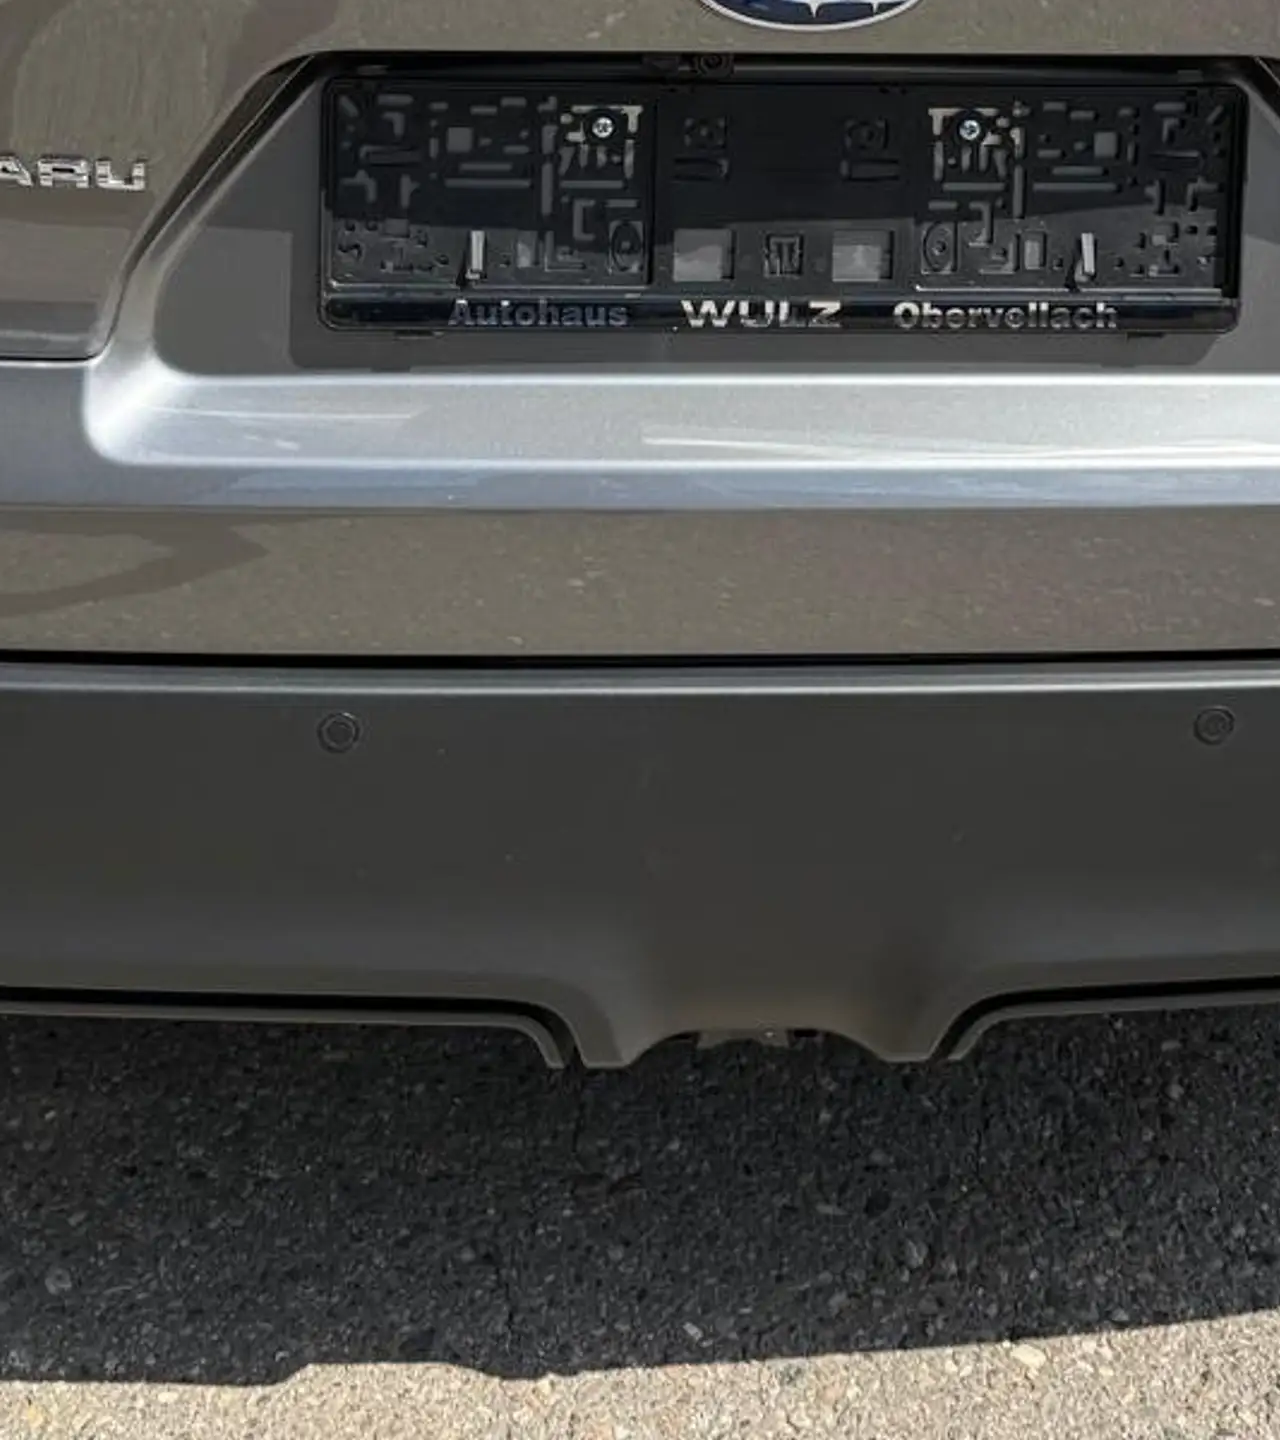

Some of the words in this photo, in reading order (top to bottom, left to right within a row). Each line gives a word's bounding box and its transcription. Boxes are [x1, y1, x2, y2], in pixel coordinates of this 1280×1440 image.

[448, 299, 629, 326] Autohaus
[681, 300, 841, 327] WULZ
[892, 301, 1117, 328] Obervellach
